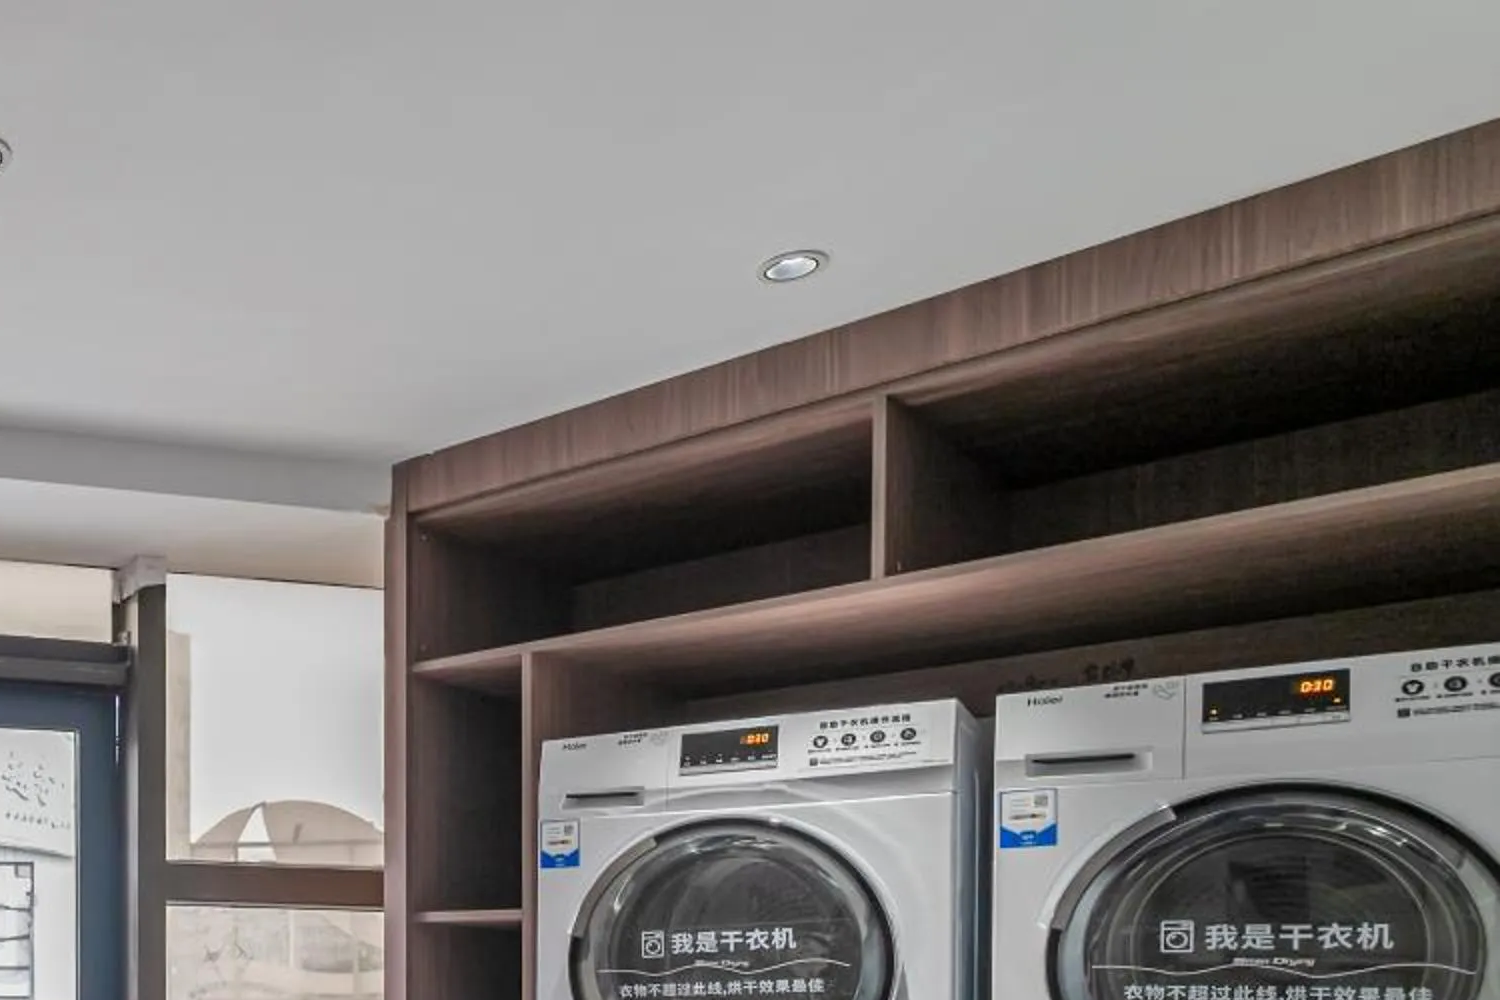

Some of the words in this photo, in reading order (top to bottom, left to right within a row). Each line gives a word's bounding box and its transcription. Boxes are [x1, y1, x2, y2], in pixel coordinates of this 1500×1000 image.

[671, 927, 797, 955] 我是干衣机
[1205, 922, 1395, 951] 我是干衣机
